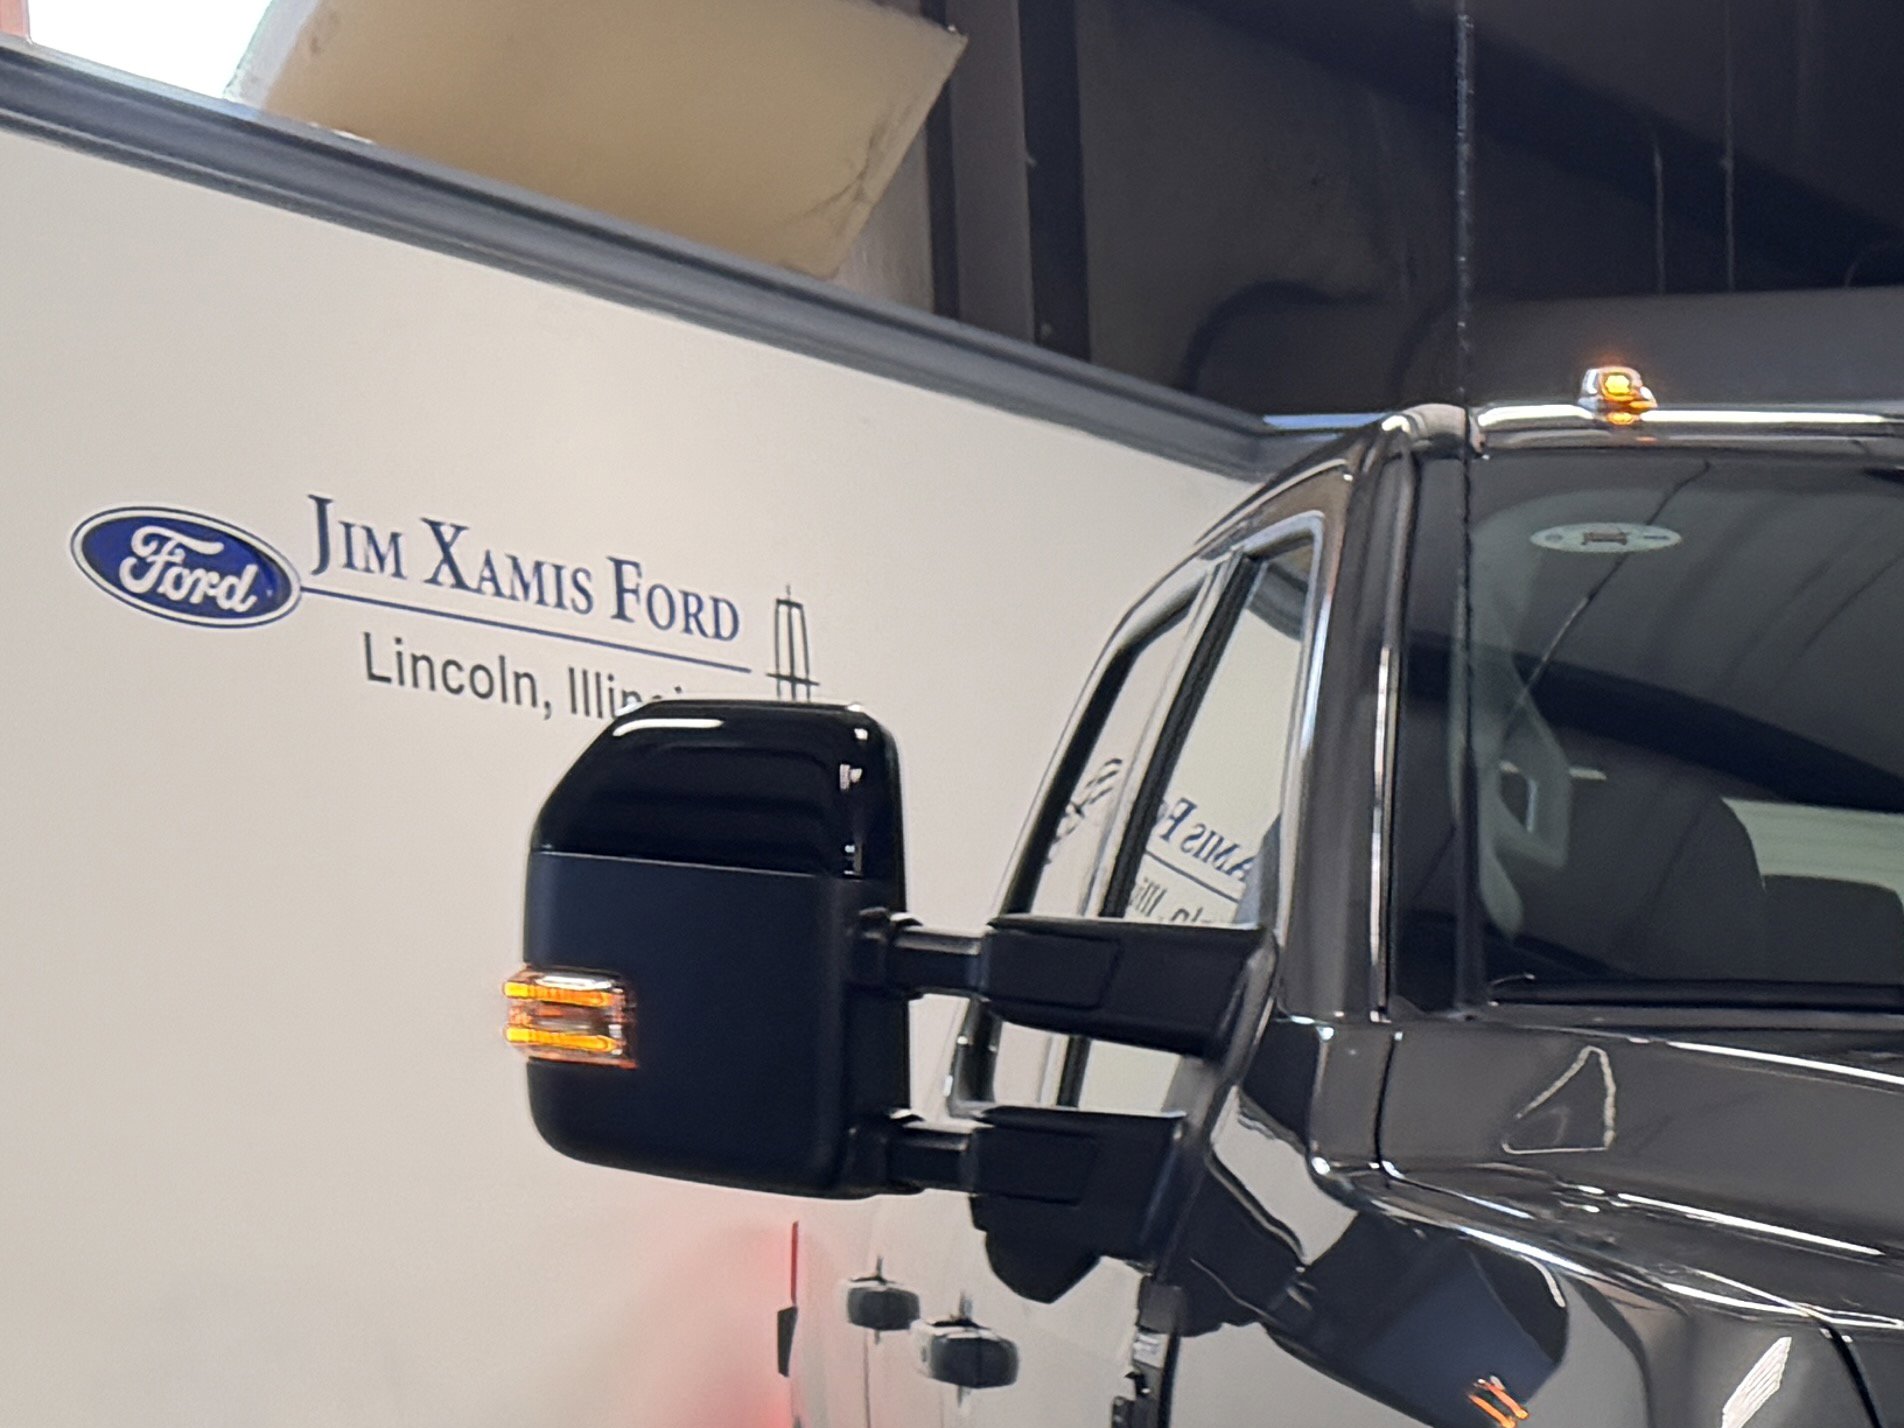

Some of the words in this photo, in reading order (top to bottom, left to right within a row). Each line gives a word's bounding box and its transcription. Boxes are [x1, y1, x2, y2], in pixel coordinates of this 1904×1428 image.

[118, 526, 257, 613] Ford
[308, 494, 406, 580] JIM
[421, 517, 594, 615] XAMIS
[606, 556, 741, 642] FORD
[363, 631, 552, 720] Lincoln,
